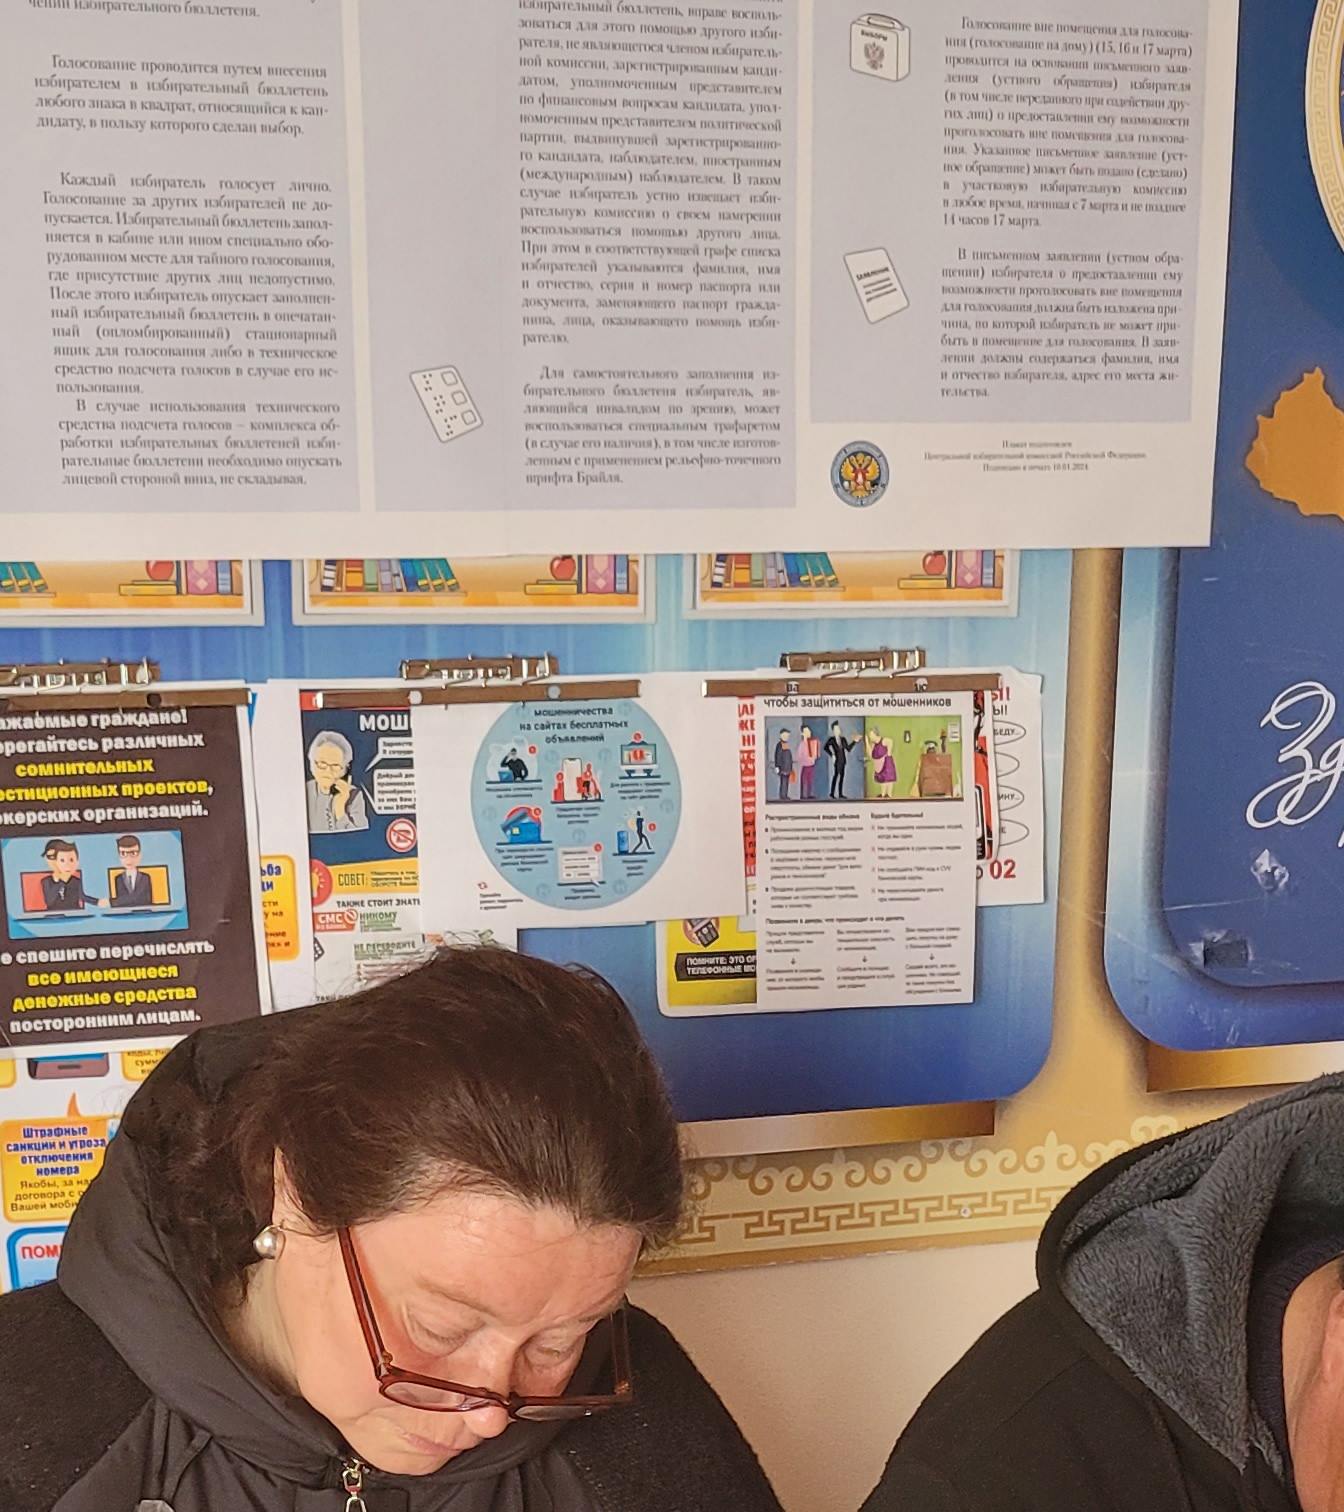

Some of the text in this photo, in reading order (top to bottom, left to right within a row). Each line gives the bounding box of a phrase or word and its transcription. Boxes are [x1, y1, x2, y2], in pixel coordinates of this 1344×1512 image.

[52, 54, 136, 72] Голосование
[142, 60, 218, 78] проводится
[223, 64, 262, 80] путем
[35, 74, 120, 91] избирателем
[147, 80, 248, 96] избирательный
[257, 81, 328, 98] бюллетень
[36, 94, 86, 110] любого
[88, 98, 126, 110] знака
[101, 119, 146, 133] пользу
[150, 120, 209, 134] которого
[213, 122, 256, 134] сделан
[260, 120, 304, 137] выбор.
[60, 172, 116, 188] Каждый
[130, 174, 206, 191] избиратель
[219, 179, 275, 194] голосует
[764, 697, 952, 709] чтобы защититься от мошенников
[91, 709, 187, 727] граждане!
[534, 707, 613, 717] мошенничества
[359, 713, 412, 731] МОШ
[520, 720, 628, 731] на сайтах бесплатных
[101, 733, 205, 752] различных
[545, 734, 605, 744] объявлений
[15, 759, 154, 778] сомнительных
[121, 781, 214, 799] проектов,
[83, 800, 209, 823] организаций.
[989, 859, 1016, 879] 02
[338, 873, 368, 886] СОВЕТ:
[318, 914, 344, 924] СМС
[360, 911, 398, 920] НИКОМУ
[16, 946, 97, 964] спешите
[100, 940, 215, 960] перечислять
[28, 965, 178, 987] все имеющиеся
[13, 986, 197, 1012] денежные средства
[10, 1010, 202, 1034] посторонним лицам.
[22, 1126, 88, 1139] Штрафные
[6, 1138, 106, 1152] санкции и угроза
[21, 1152, 93, 1165] отключения
[36, 1166, 80, 1176] номера
[20, 1179, 73, 1189] Якобы, за
[15, 1190, 66, 1201] договора
[11, 1201, 47, 1212] Вашей
